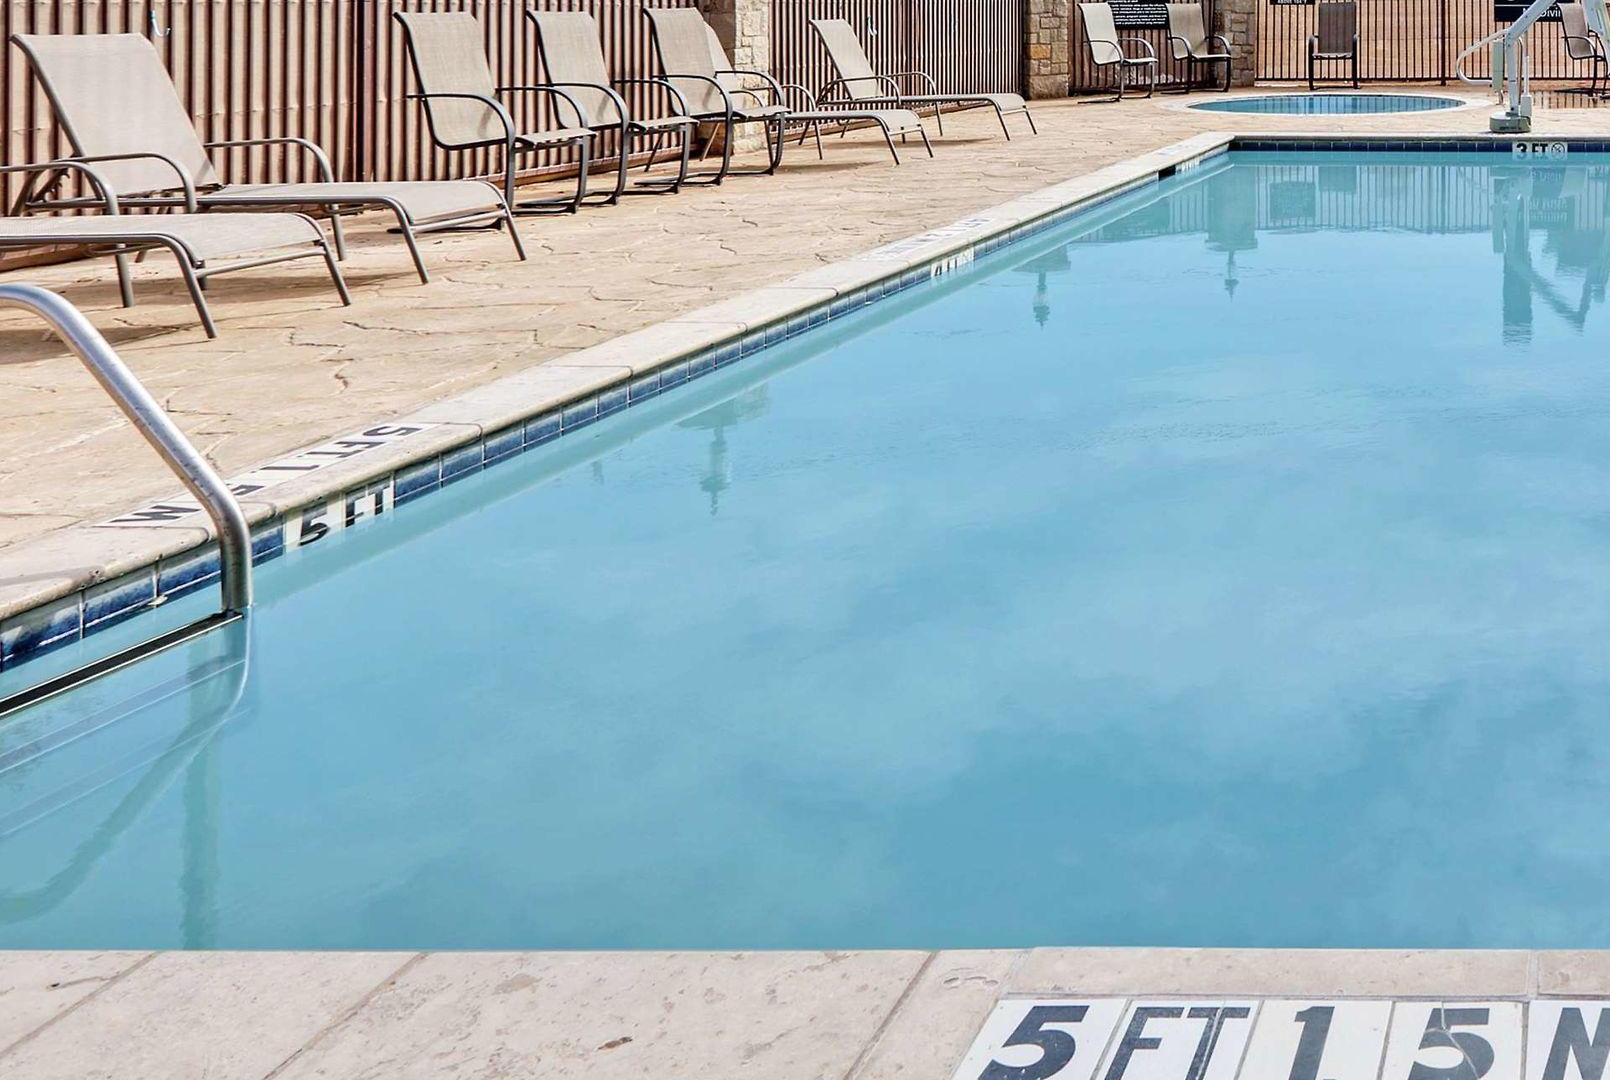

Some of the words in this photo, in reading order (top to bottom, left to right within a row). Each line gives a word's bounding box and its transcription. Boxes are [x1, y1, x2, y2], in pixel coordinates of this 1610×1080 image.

[1532, 142, 1549, 153] FT
[298, 502, 331, 547] 5
[345, 477, 392, 528] FT
[977, 1005, 1091, 1080] 5
[1103, 1006, 1251, 1080] FT
